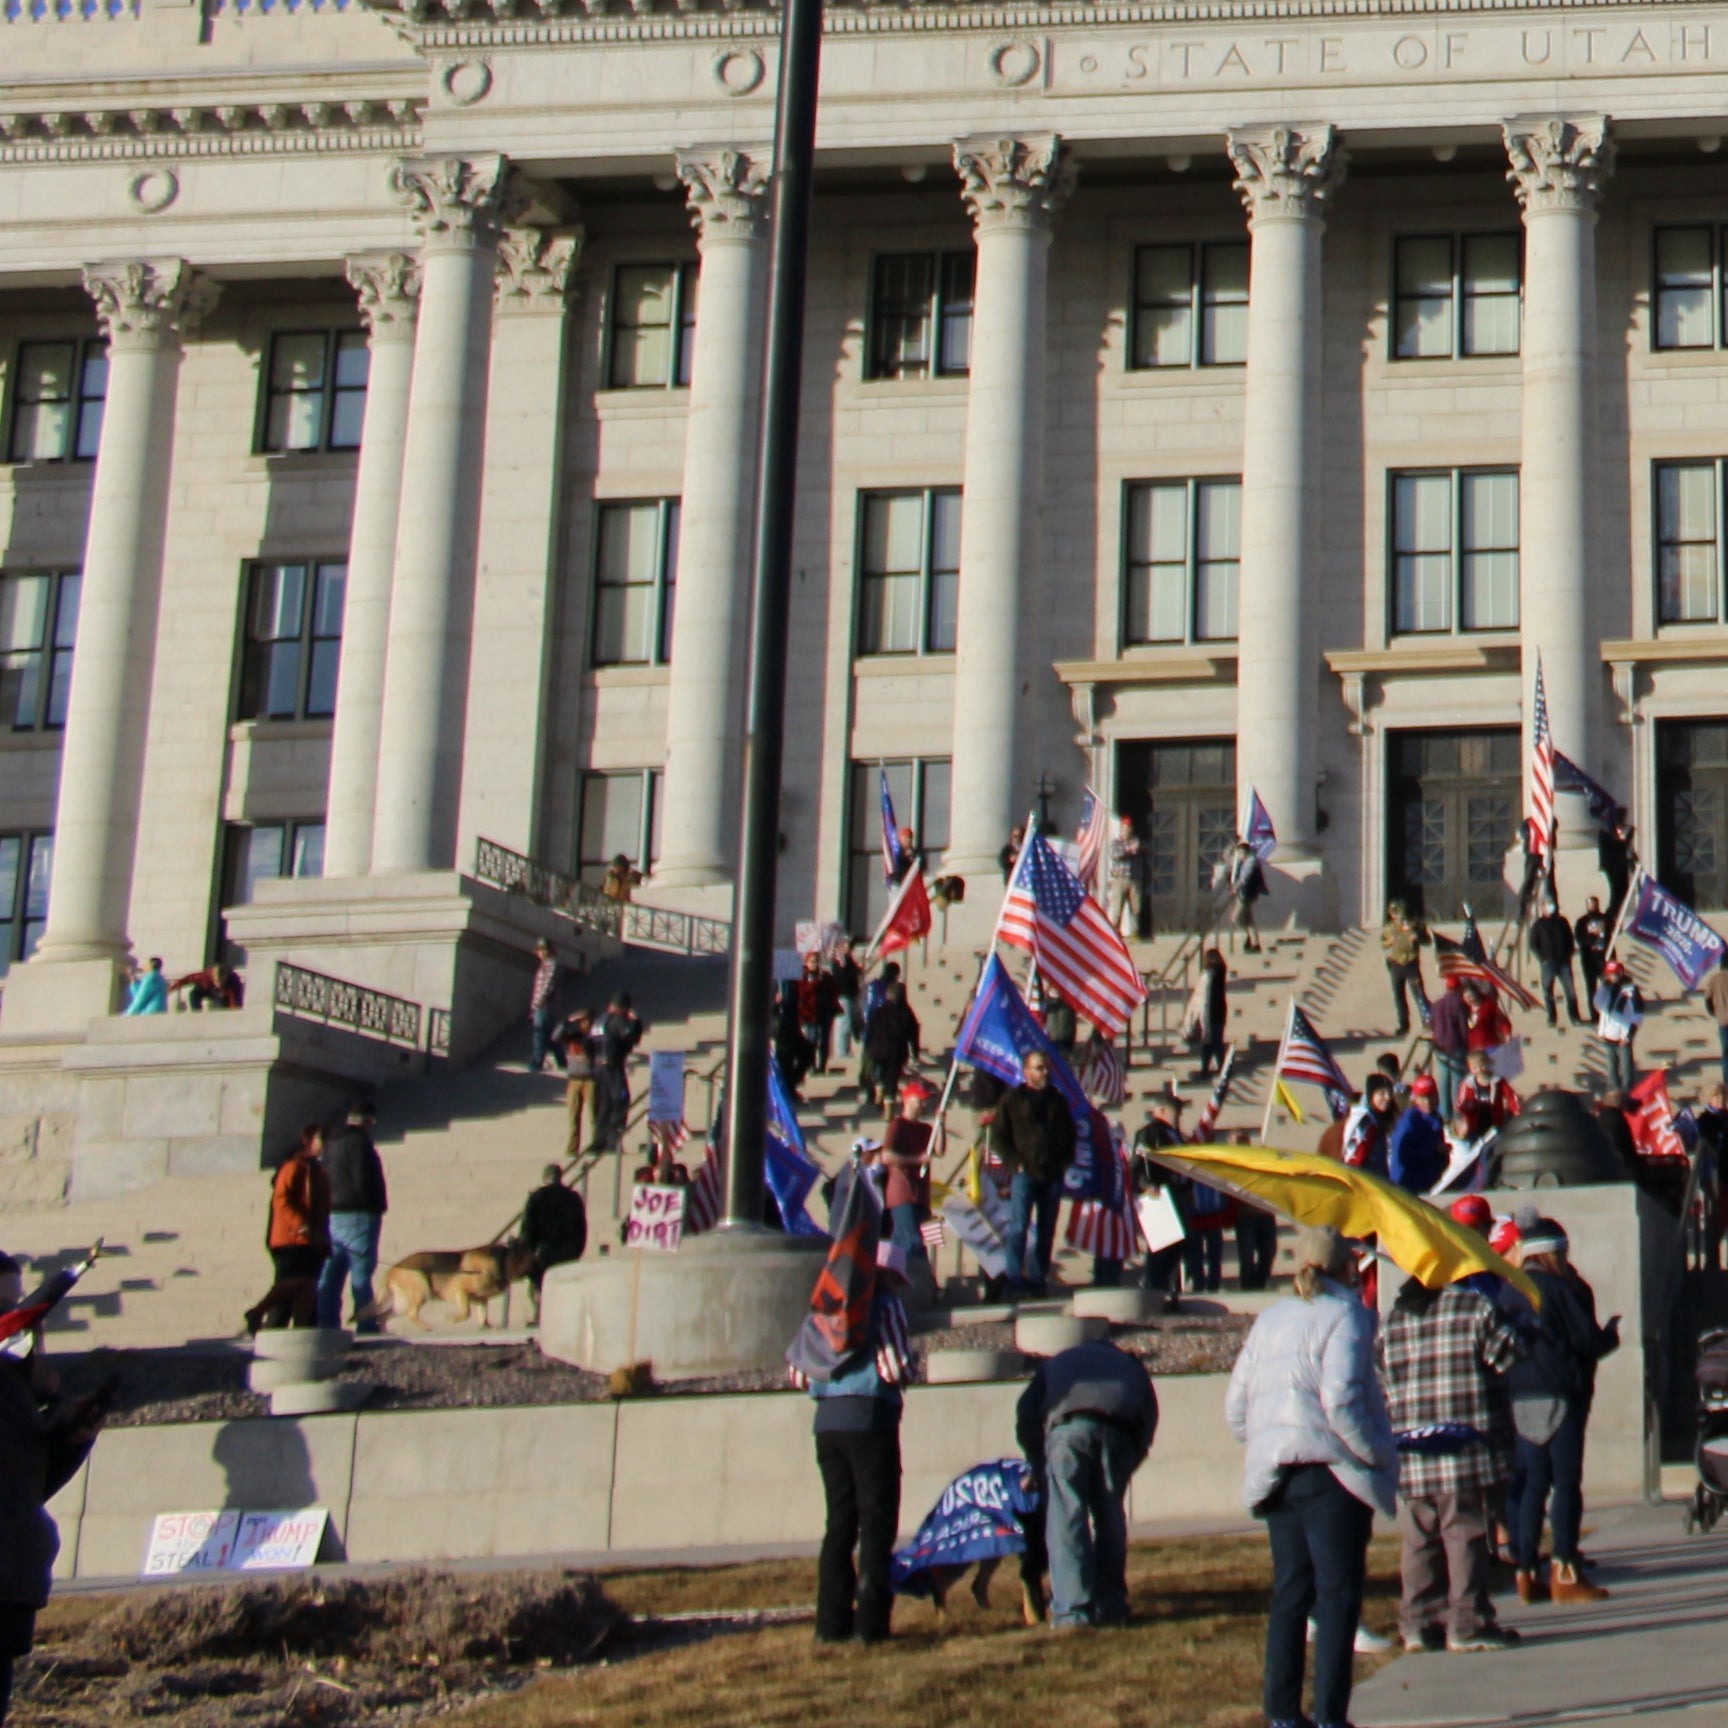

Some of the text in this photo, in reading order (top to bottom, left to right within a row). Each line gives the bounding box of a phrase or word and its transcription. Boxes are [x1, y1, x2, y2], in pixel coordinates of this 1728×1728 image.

[1125, 24, 1712, 80] STATE OF UTAH
[1651, 890, 1721, 951] TRUMP
[634, 1187, 681, 1215] JOE
[159, 1514, 235, 1540] STOP
